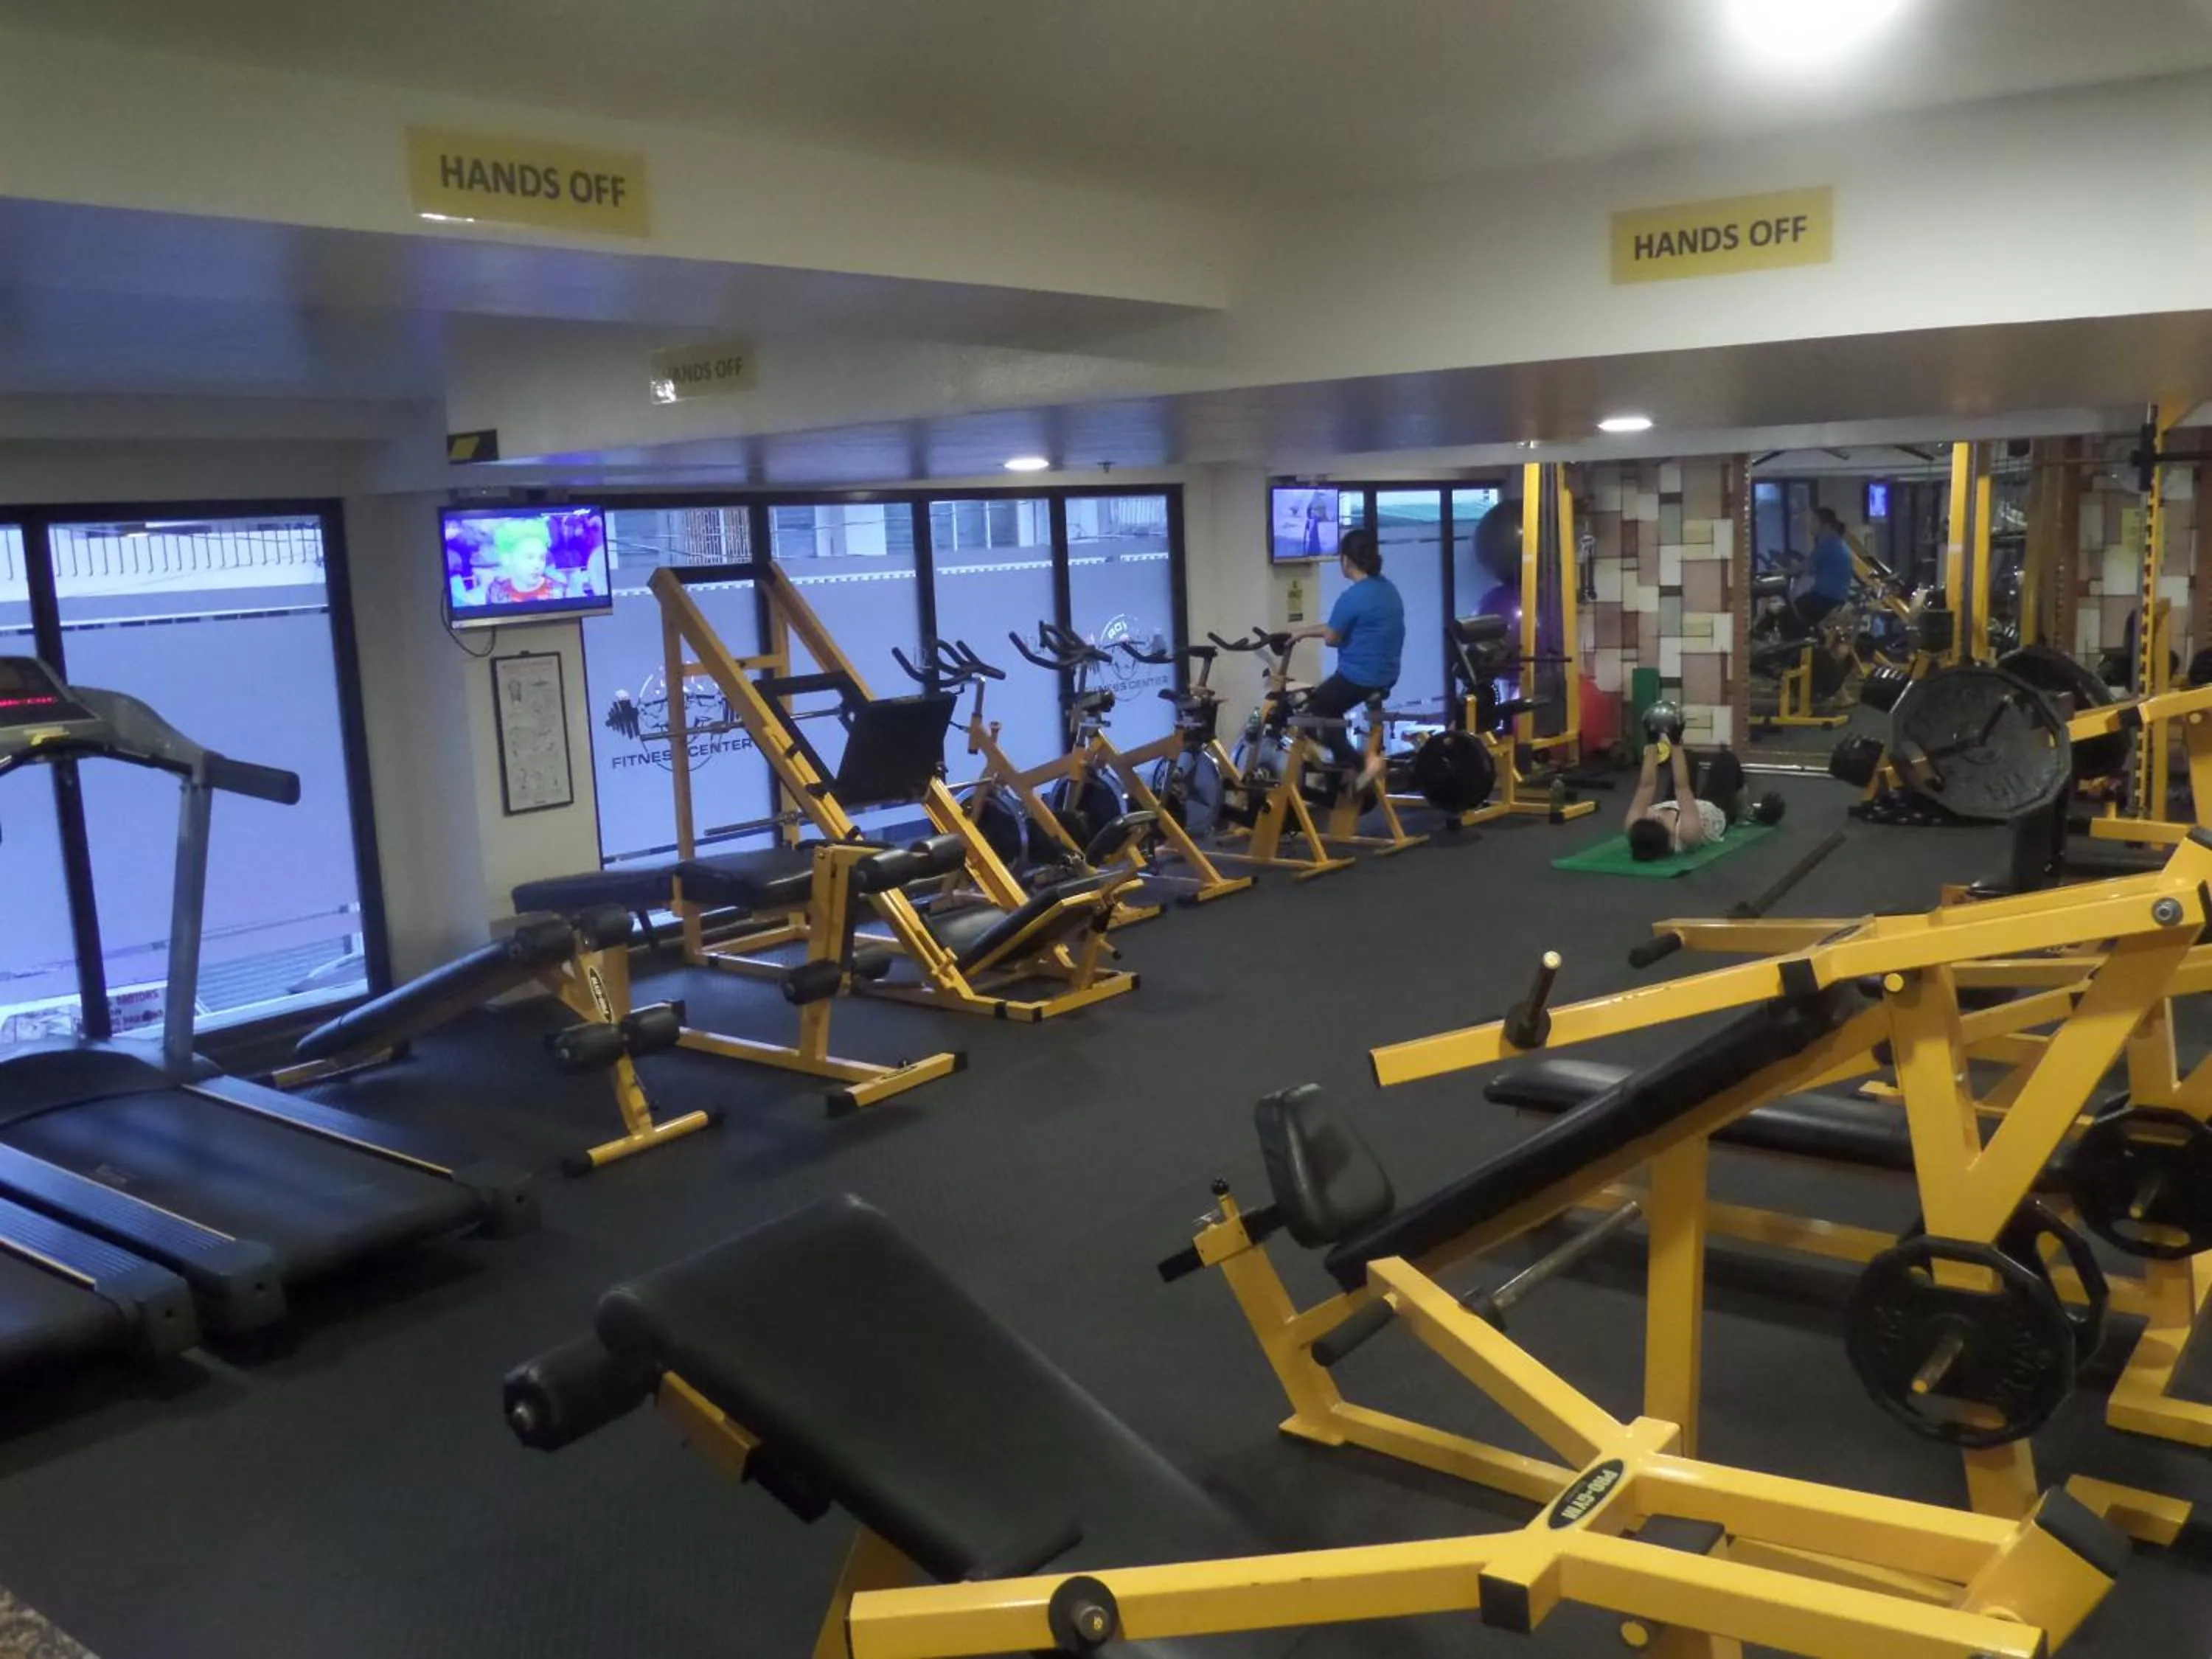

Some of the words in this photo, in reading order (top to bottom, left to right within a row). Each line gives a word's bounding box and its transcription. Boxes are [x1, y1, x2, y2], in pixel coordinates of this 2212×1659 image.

[440, 154, 561, 201] HANDS
[569, 170, 626, 208] OFF
[1634, 223, 1740, 261] HANDS
[1749, 215, 1808, 247] OFF
[715, 356, 743, 379] OFF
[1129, 675, 1169, 689] CENTER
[611, 749, 672, 769] FITNES
[687, 737, 753, 757] CENTER
